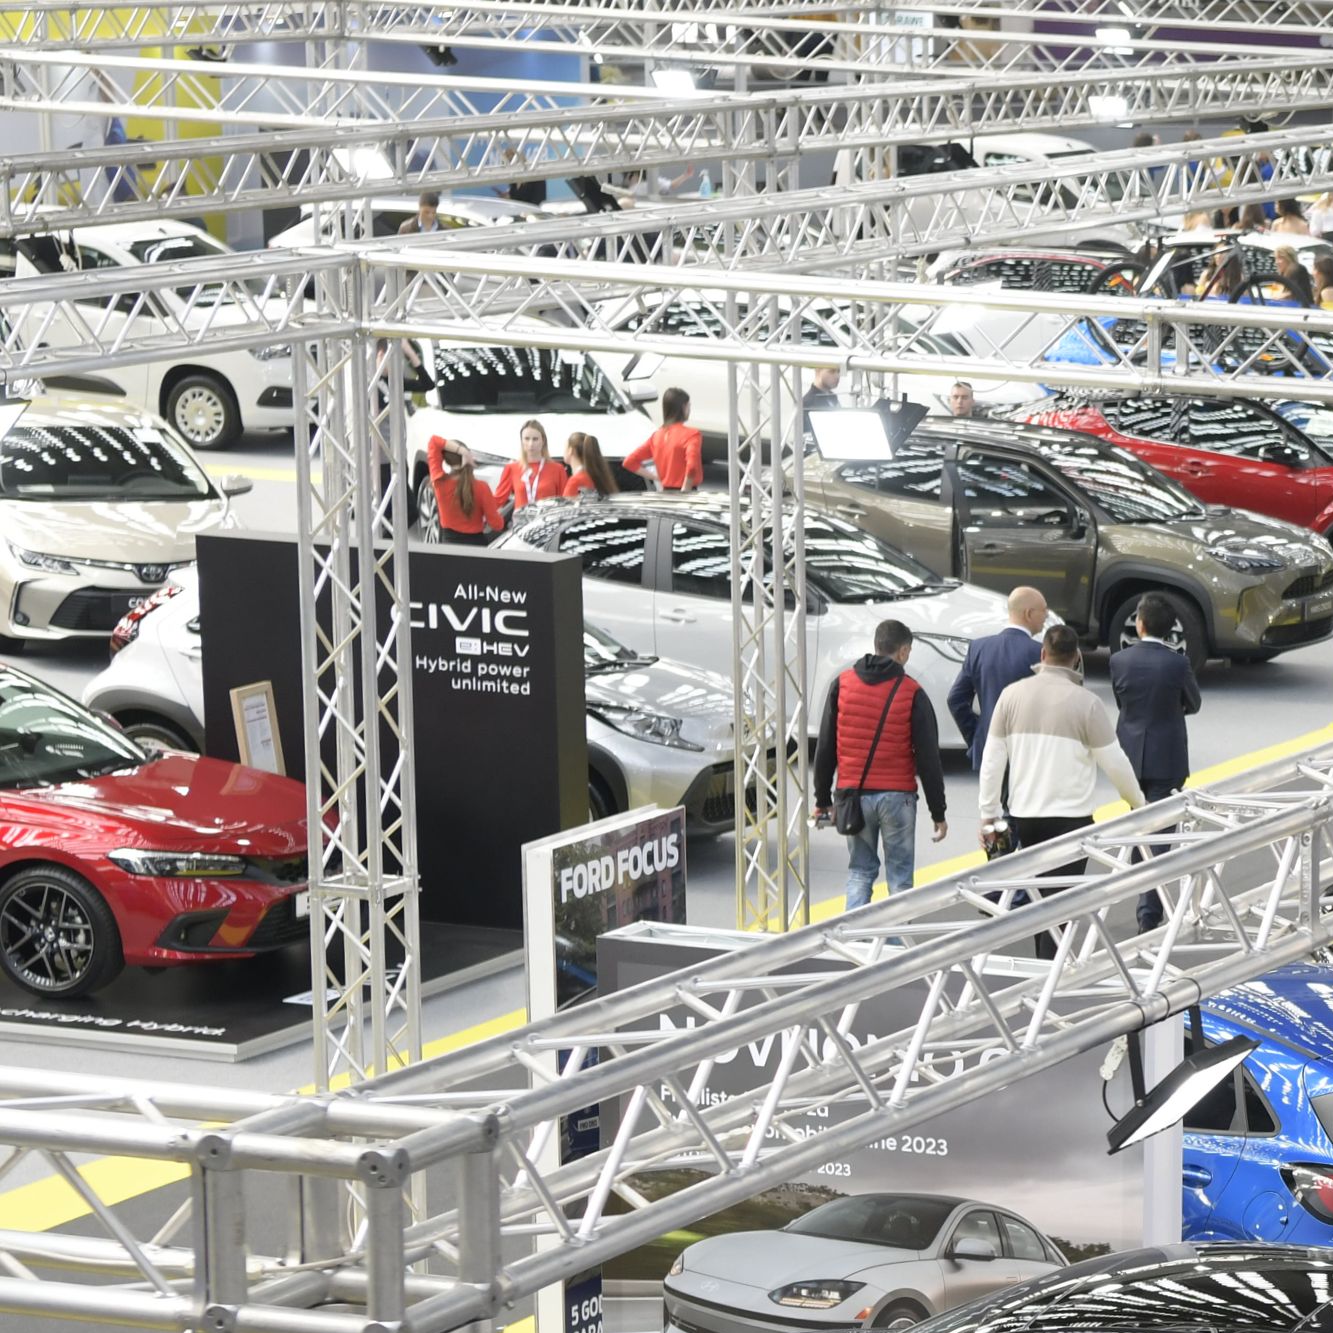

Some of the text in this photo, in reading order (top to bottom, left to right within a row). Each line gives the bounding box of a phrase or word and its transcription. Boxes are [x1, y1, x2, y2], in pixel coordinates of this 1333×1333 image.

[453, 583, 527, 605] All-New
[415, 654, 530, 678] Hybrid power
[450, 675, 531, 696] unlimited
[560, 832, 680, 904] FORD FOCUS
[900, 1135, 949, 1157] 2023
[816, 1162, 852, 1177] 2023
[571, 1304, 580, 1327] 5
